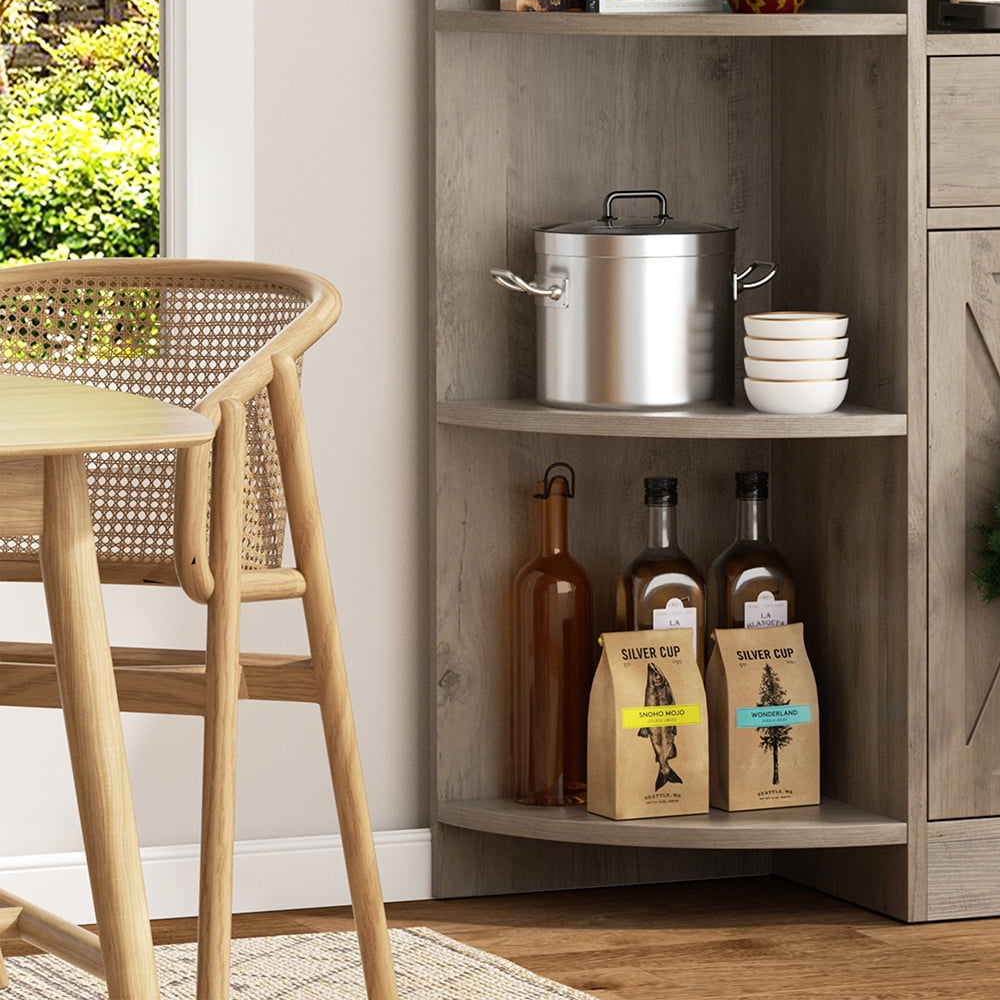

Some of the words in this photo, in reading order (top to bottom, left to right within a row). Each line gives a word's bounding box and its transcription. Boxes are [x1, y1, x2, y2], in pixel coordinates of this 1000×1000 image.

[621, 647, 657, 661] SILVER
[659, 645, 681, 658] CUP
[736, 650, 771, 661] SILVER
[773, 648, 794, 659] CUP
[751, 709, 798, 718] WONDERLAND
